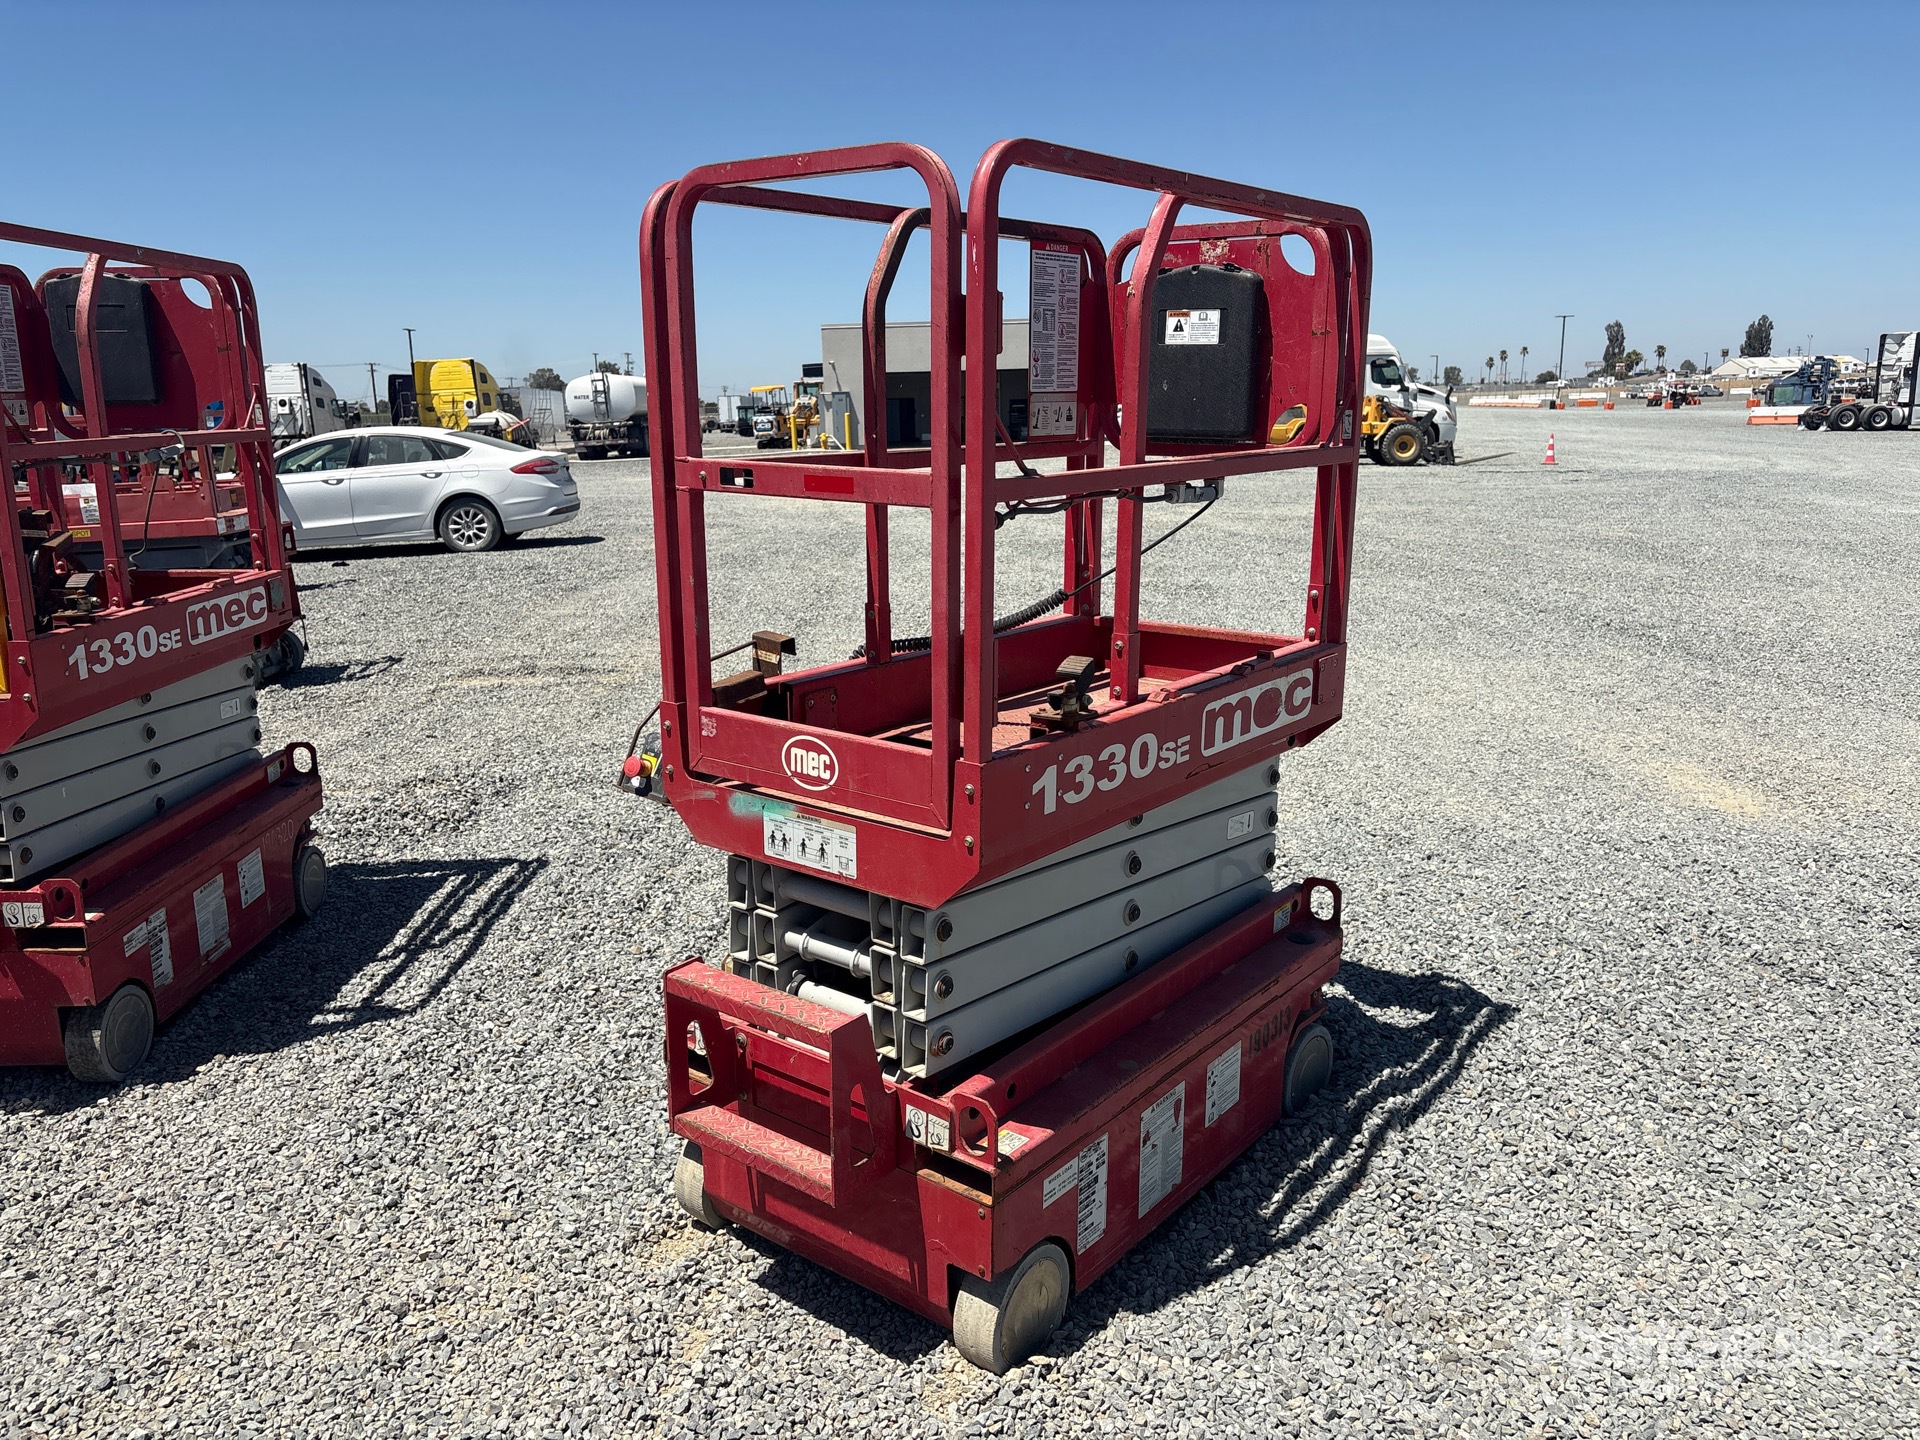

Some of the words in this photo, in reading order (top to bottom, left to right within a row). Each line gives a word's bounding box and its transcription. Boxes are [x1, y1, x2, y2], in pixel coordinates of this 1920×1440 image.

[1050, 243, 1069, 253] DANGER
[187, 590, 267, 640] mec
[790, 746, 831, 780] mec
[801, 814, 822, 824] WARNING
[1155, 1088, 1177, 1110] WARNING
[1062, 1164, 1073, 1175] LOAD
